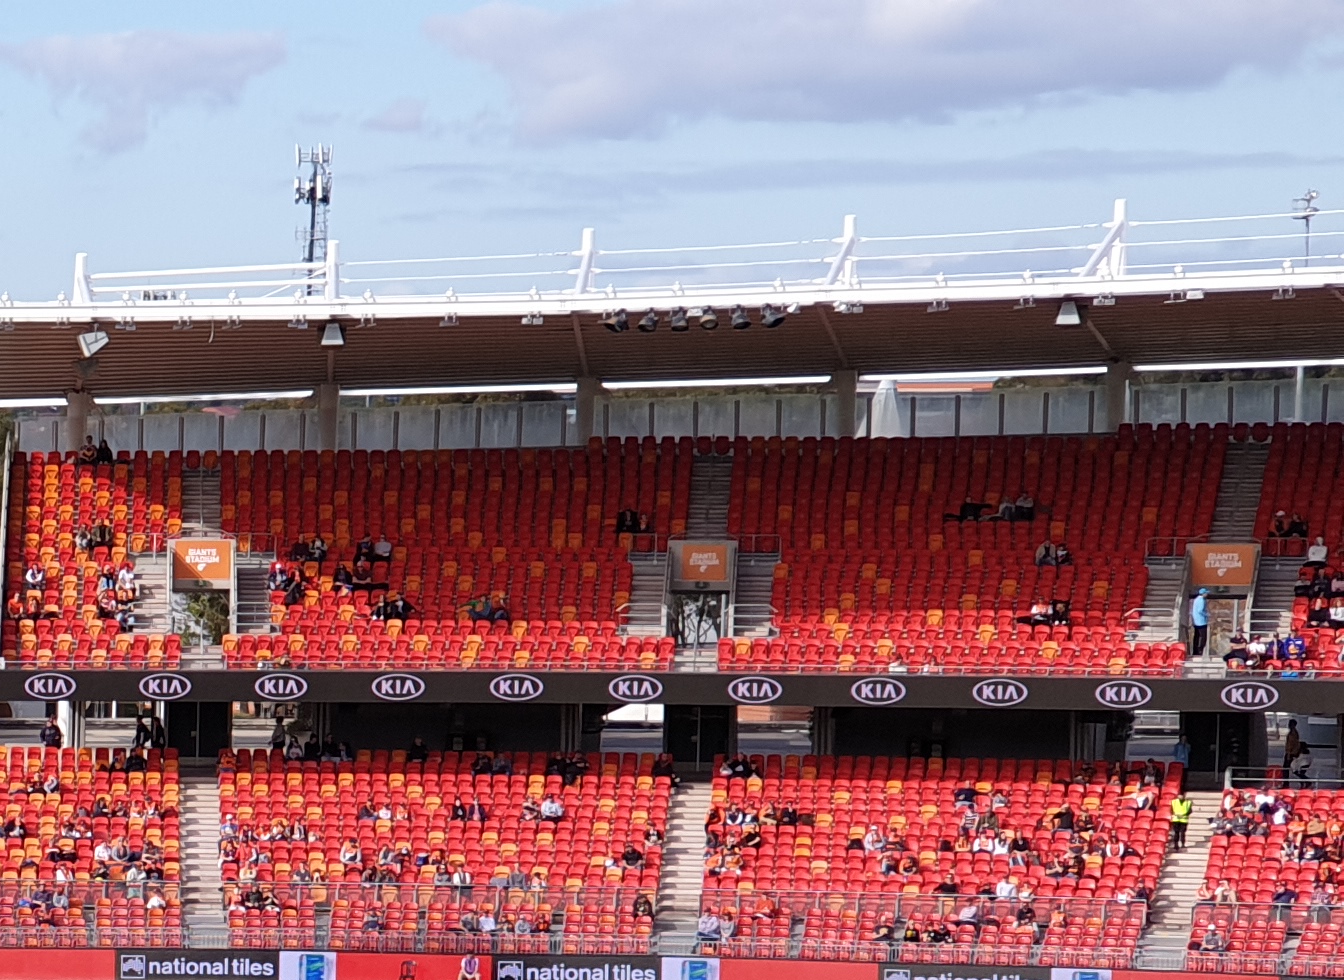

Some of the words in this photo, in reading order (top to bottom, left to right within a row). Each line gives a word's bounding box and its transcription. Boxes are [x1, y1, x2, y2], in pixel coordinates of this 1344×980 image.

[32, 678, 69, 694] KIA
[147, 678, 184, 694] KIA
[263, 679, 300, 694] KIA
[380, 679, 417, 695] KIA
[498, 679, 536, 695] KIA
[617, 680, 654, 696] KIA
[736, 682, 774, 698] KIA
[859, 683, 898, 699] KIA
[981, 684, 1020, 700] KIA
[1104, 686, 1143, 702] KIA
[1230, 687, 1270, 704] KIA
[148, 957, 229, 975] national
[231, 957, 274, 976] tiles
